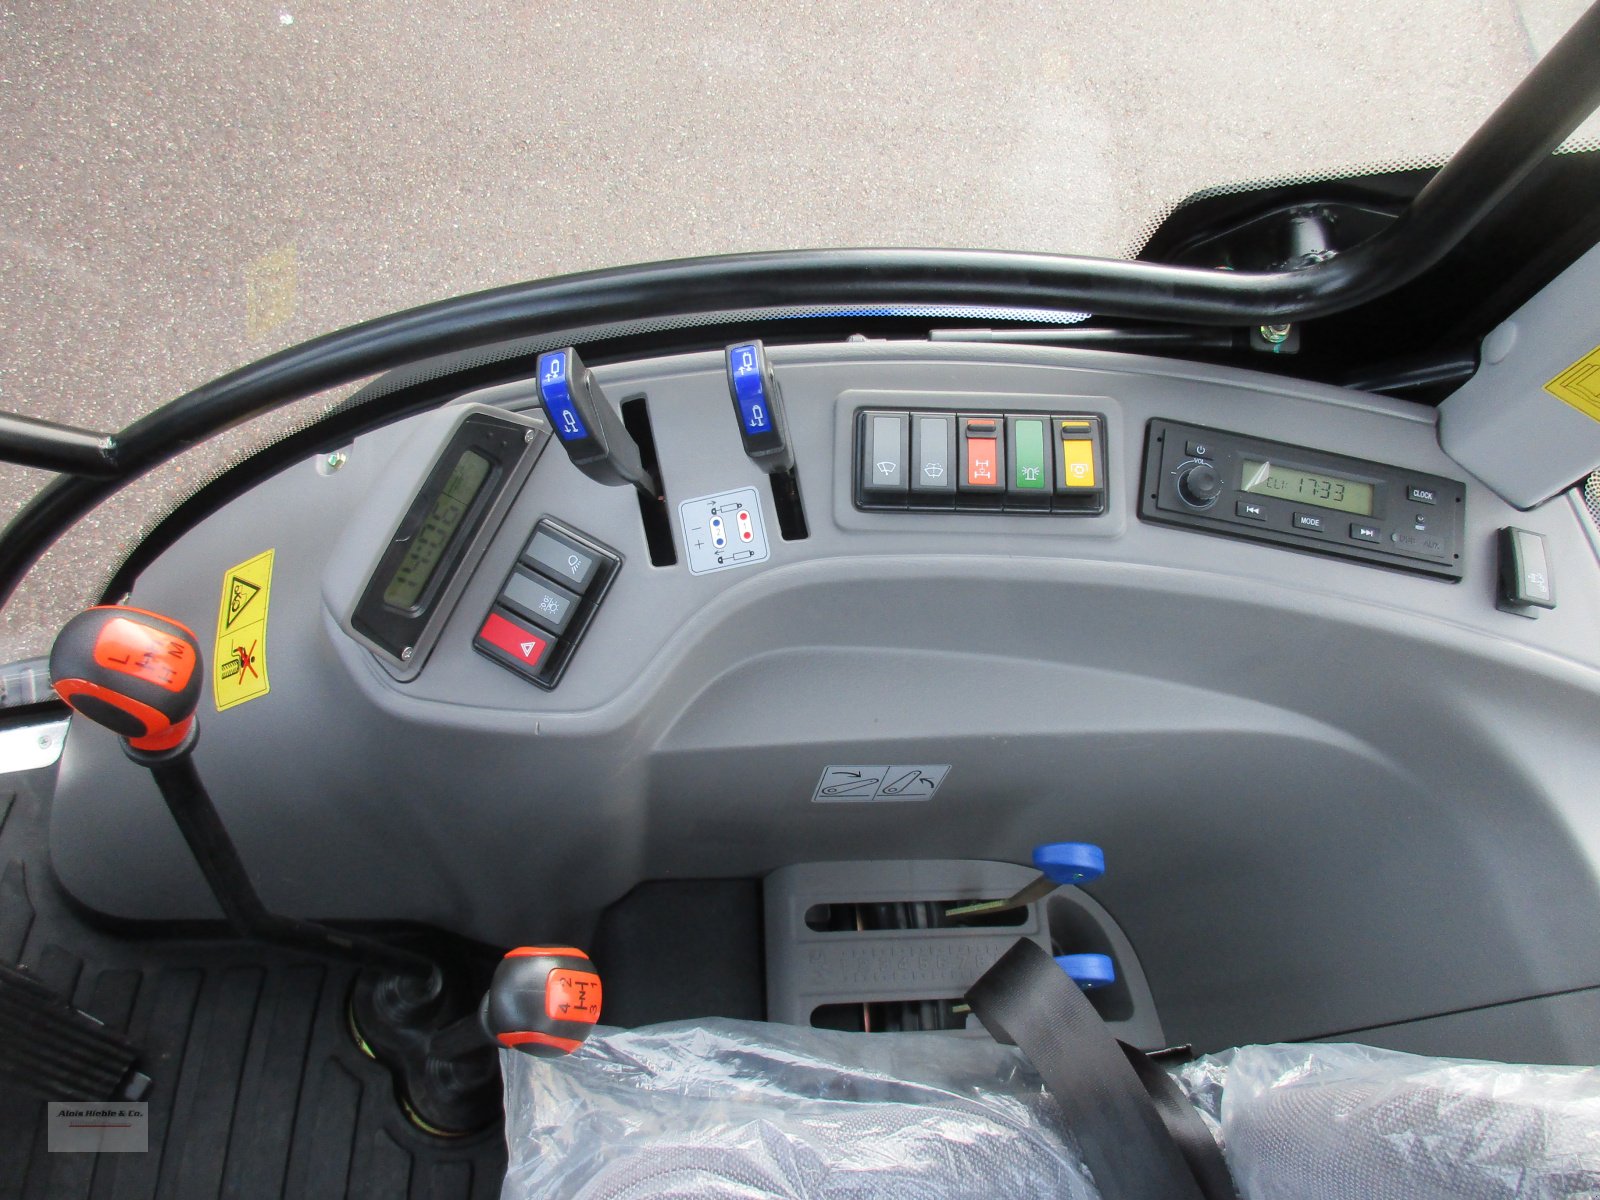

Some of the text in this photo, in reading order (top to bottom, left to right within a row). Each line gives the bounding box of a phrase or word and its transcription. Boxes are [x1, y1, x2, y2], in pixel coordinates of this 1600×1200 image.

[1193, 457, 1204, 465] VOL
[1299, 477, 1345, 502] 17:33
[1413, 489, 1433, 500] CLOCK
[1301, 517, 1320, 526] MODE
[168, 641, 185, 659] M
[108, 654, 130, 664] L
[558, 977, 572, 1013] 4 2
[589, 1005, 597, 1015] 3
